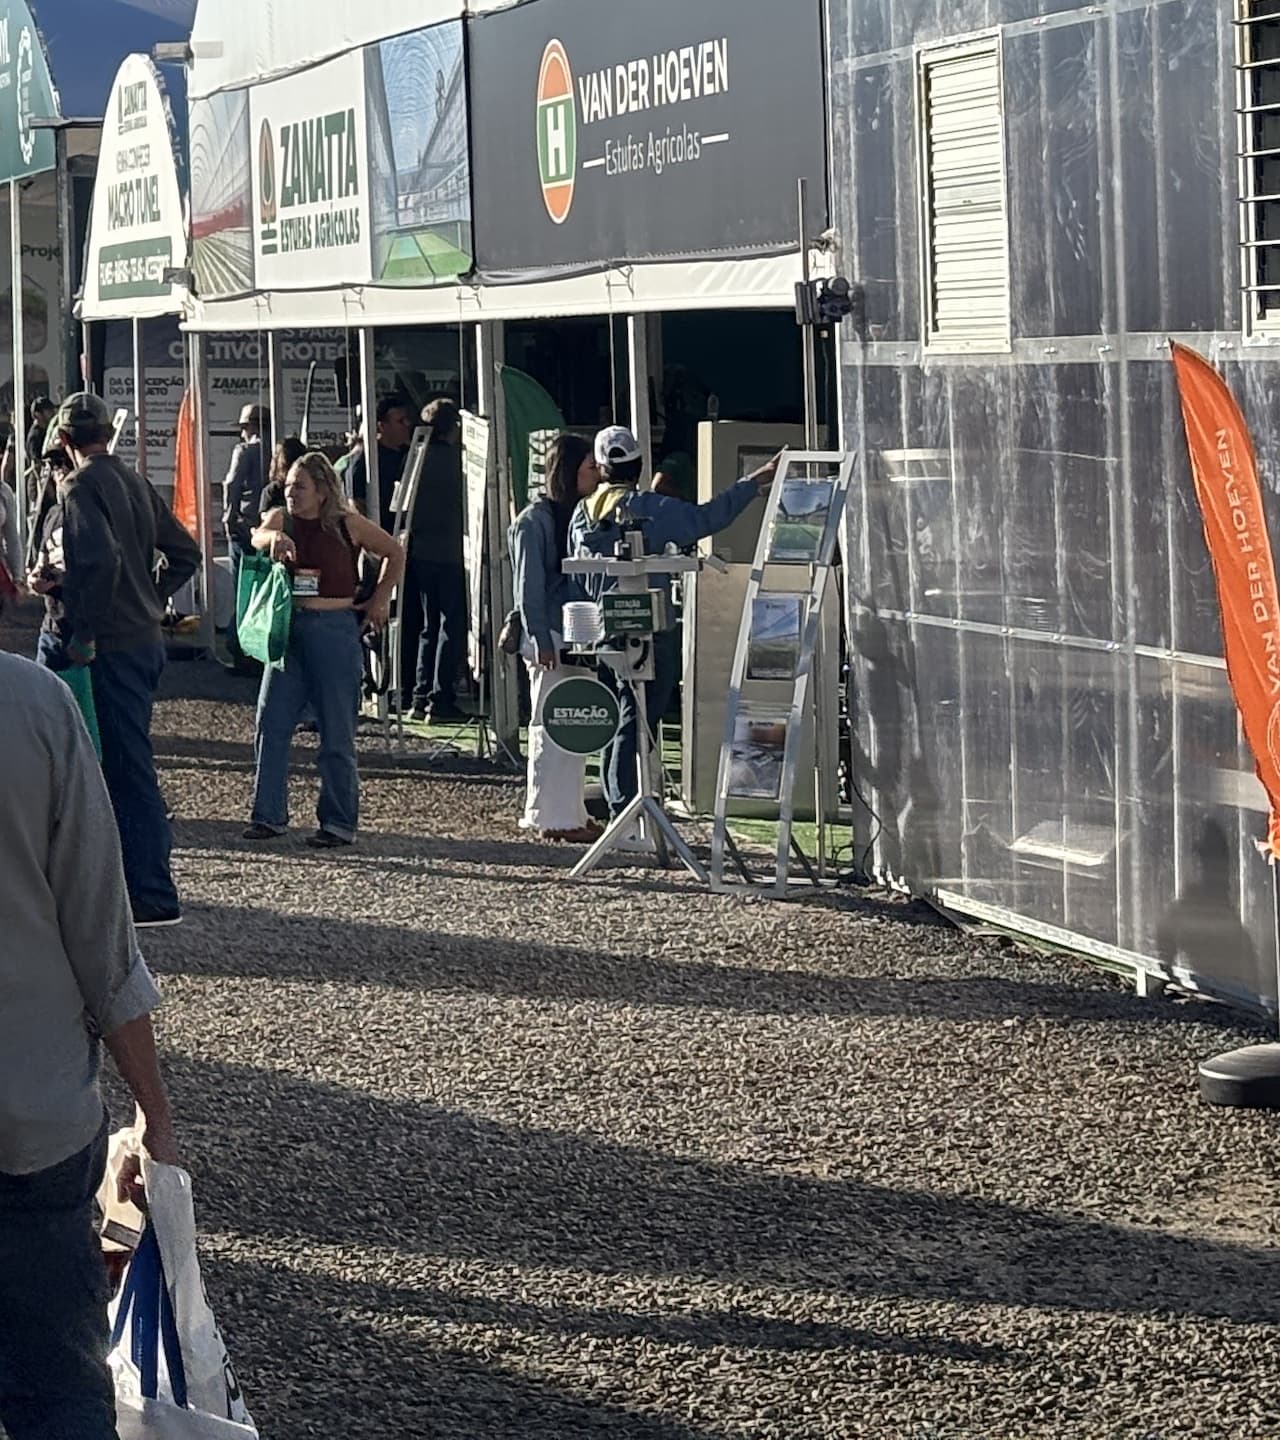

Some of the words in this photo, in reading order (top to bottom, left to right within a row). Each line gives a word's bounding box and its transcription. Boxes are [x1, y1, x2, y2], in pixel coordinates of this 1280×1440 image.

[578, 67, 612, 125] VAN
[615, 59, 650, 116] DER
[653, 37, 729, 107] HOEVEN
[280, 108, 360, 209] ZANATTA
[604, 134, 645, 176] Estufas
[646, 122, 701, 175] Agrícolas
[280, 214, 313, 253] ESTUFAS
[314, 202, 361, 249] AGRÍCOLAS
[1215, 427, 1254, 554] HOEVEN
[1247, 561, 1269, 624] DER
[1261, 631, 1280, 695] VAN
[553, 705, 609, 720] ESTAÇÃO
